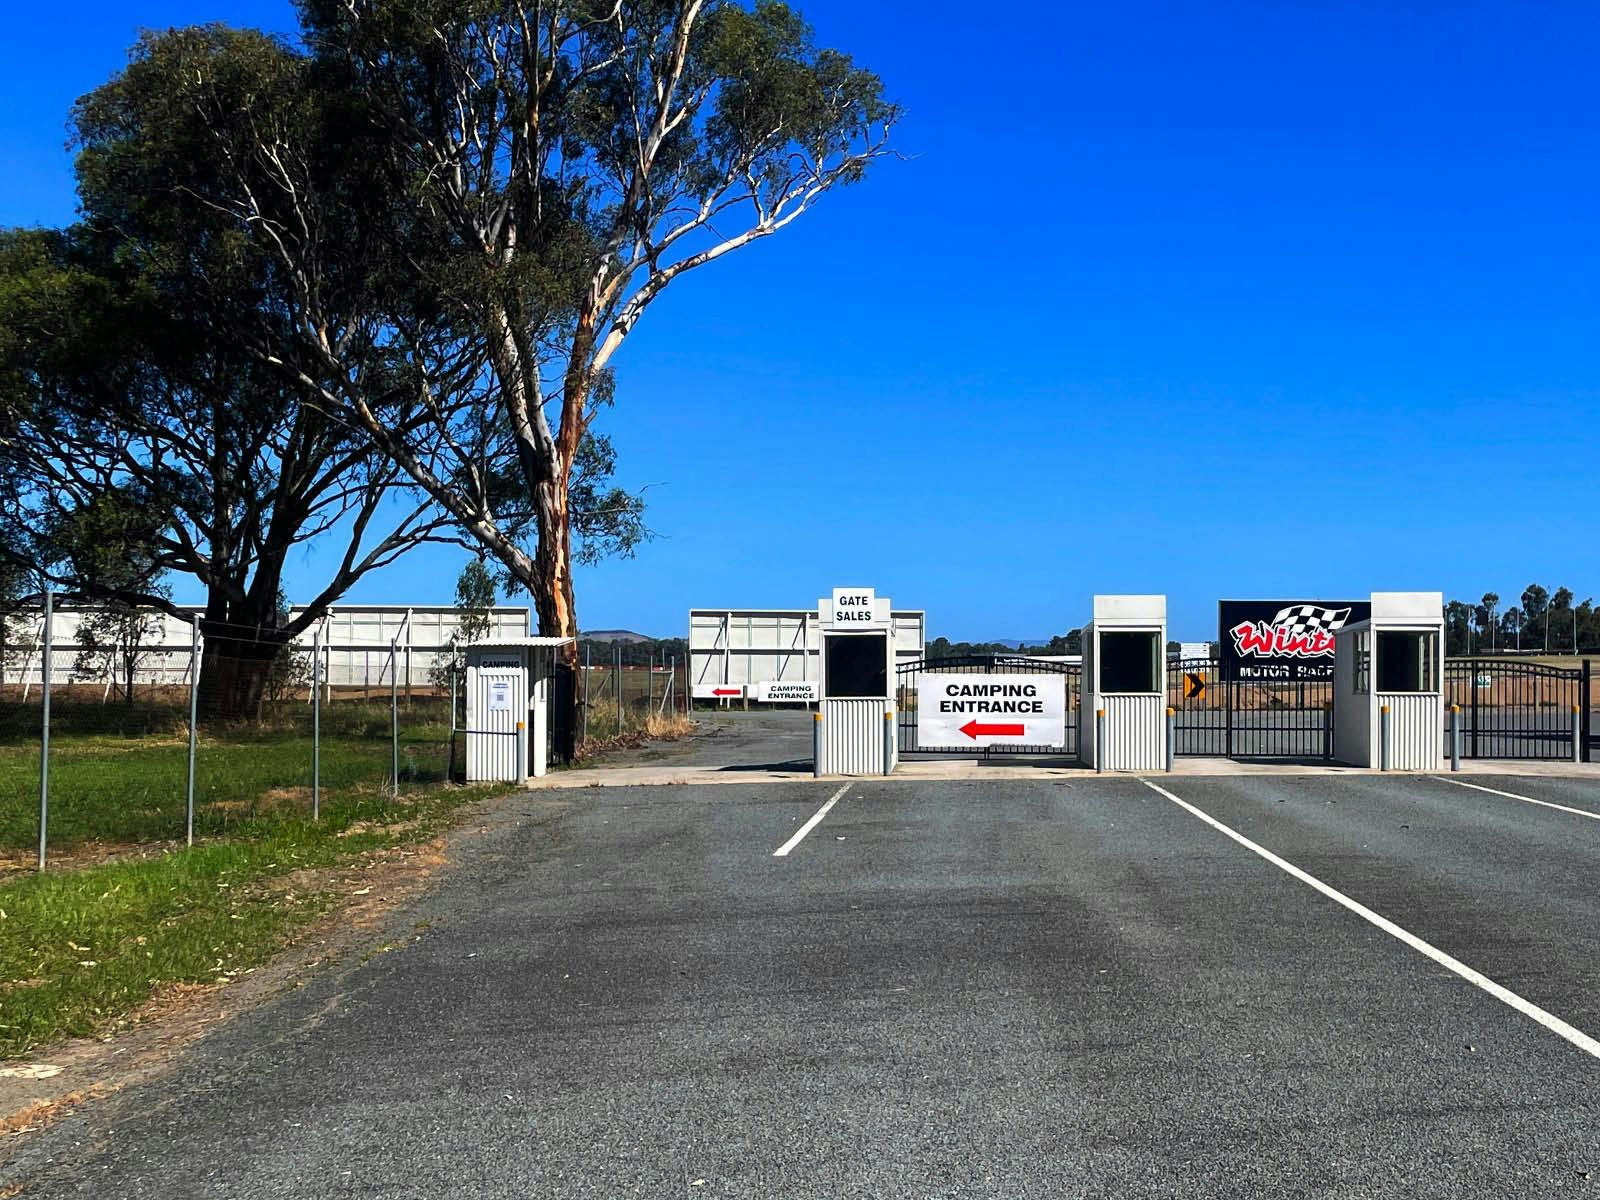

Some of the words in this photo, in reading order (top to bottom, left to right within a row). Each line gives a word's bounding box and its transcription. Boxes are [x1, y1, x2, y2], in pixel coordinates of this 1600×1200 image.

[839, 595, 868, 606] GATE
[836, 611, 872, 621] SALES
[482, 660, 520, 668] CAMPING
[1240, 665, 1290, 677] MOTOR
[945, 684, 1037, 697] CAMPING
[939, 700, 1044, 713] ENTRANCE
